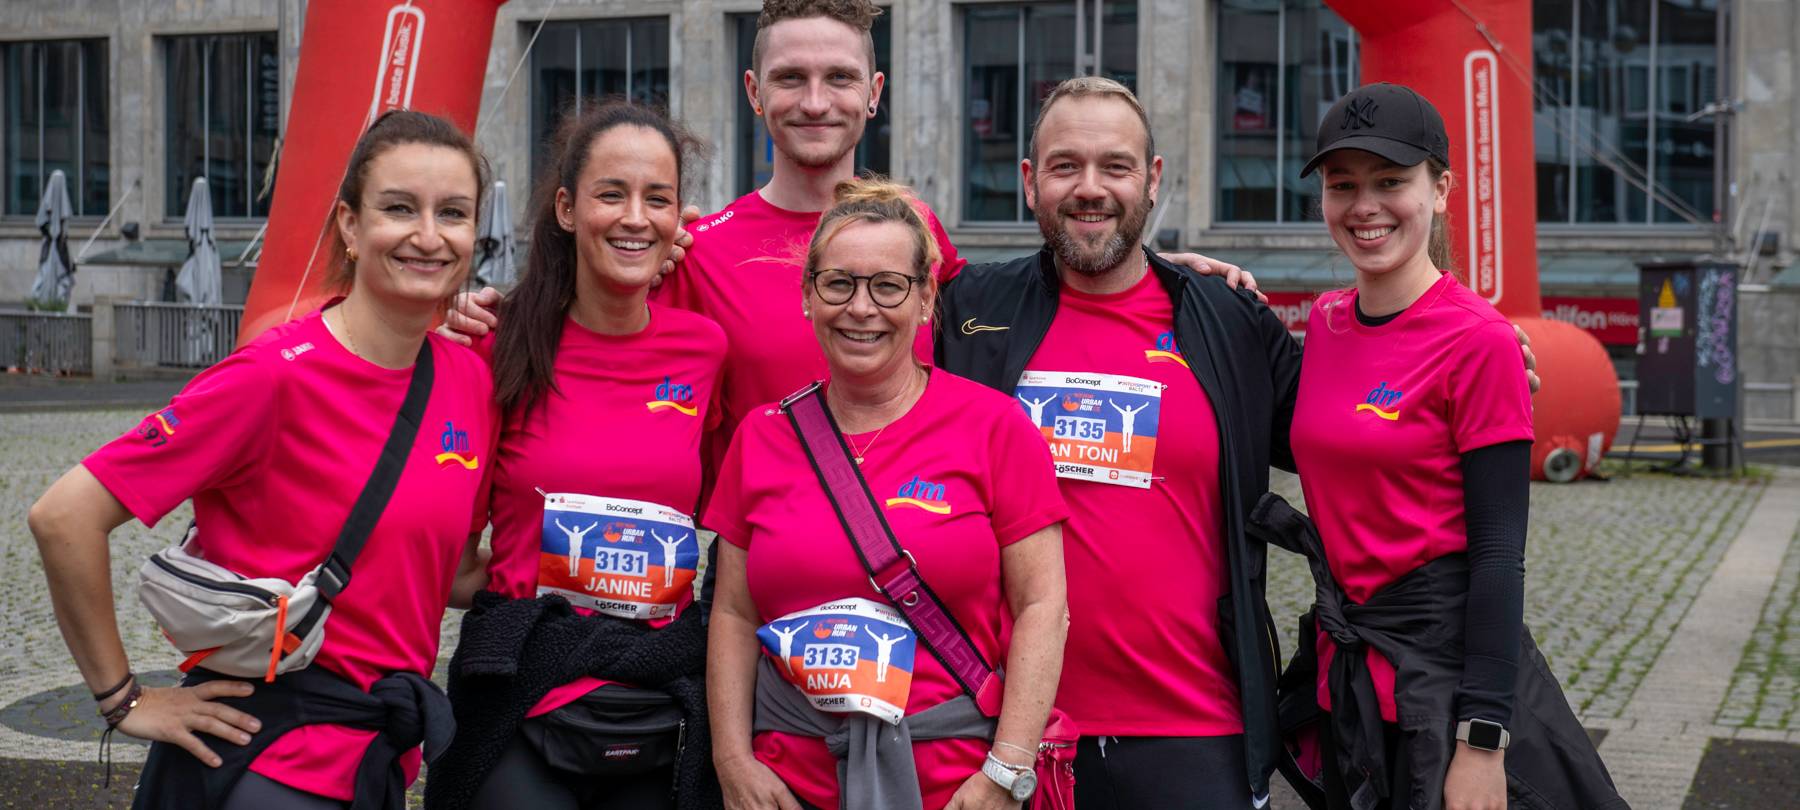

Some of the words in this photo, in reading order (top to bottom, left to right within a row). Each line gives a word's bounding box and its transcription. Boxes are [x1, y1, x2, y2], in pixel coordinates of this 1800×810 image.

[1479, 165, 1491, 201] 100%
[710, 210, 734, 227] JAKO
[1481, 253, 1493, 291] 100%
[655, 375, 693, 402] dm
[1066, 377, 1101, 387] BoConcept
[1366, 381, 1403, 408] dm
[440, 420, 470, 453] dm
[1055, 419, 1104, 440] 3135
[1077, 444, 1118, 463] TONI
[897, 475, 946, 502] dm
[606, 503, 643, 515] BoConcept
[596, 551, 645, 574] 3131
[585, 577, 652, 598] JANINE
[805, 647, 857, 666] 3133
[807, 673, 852, 690] ANJA
